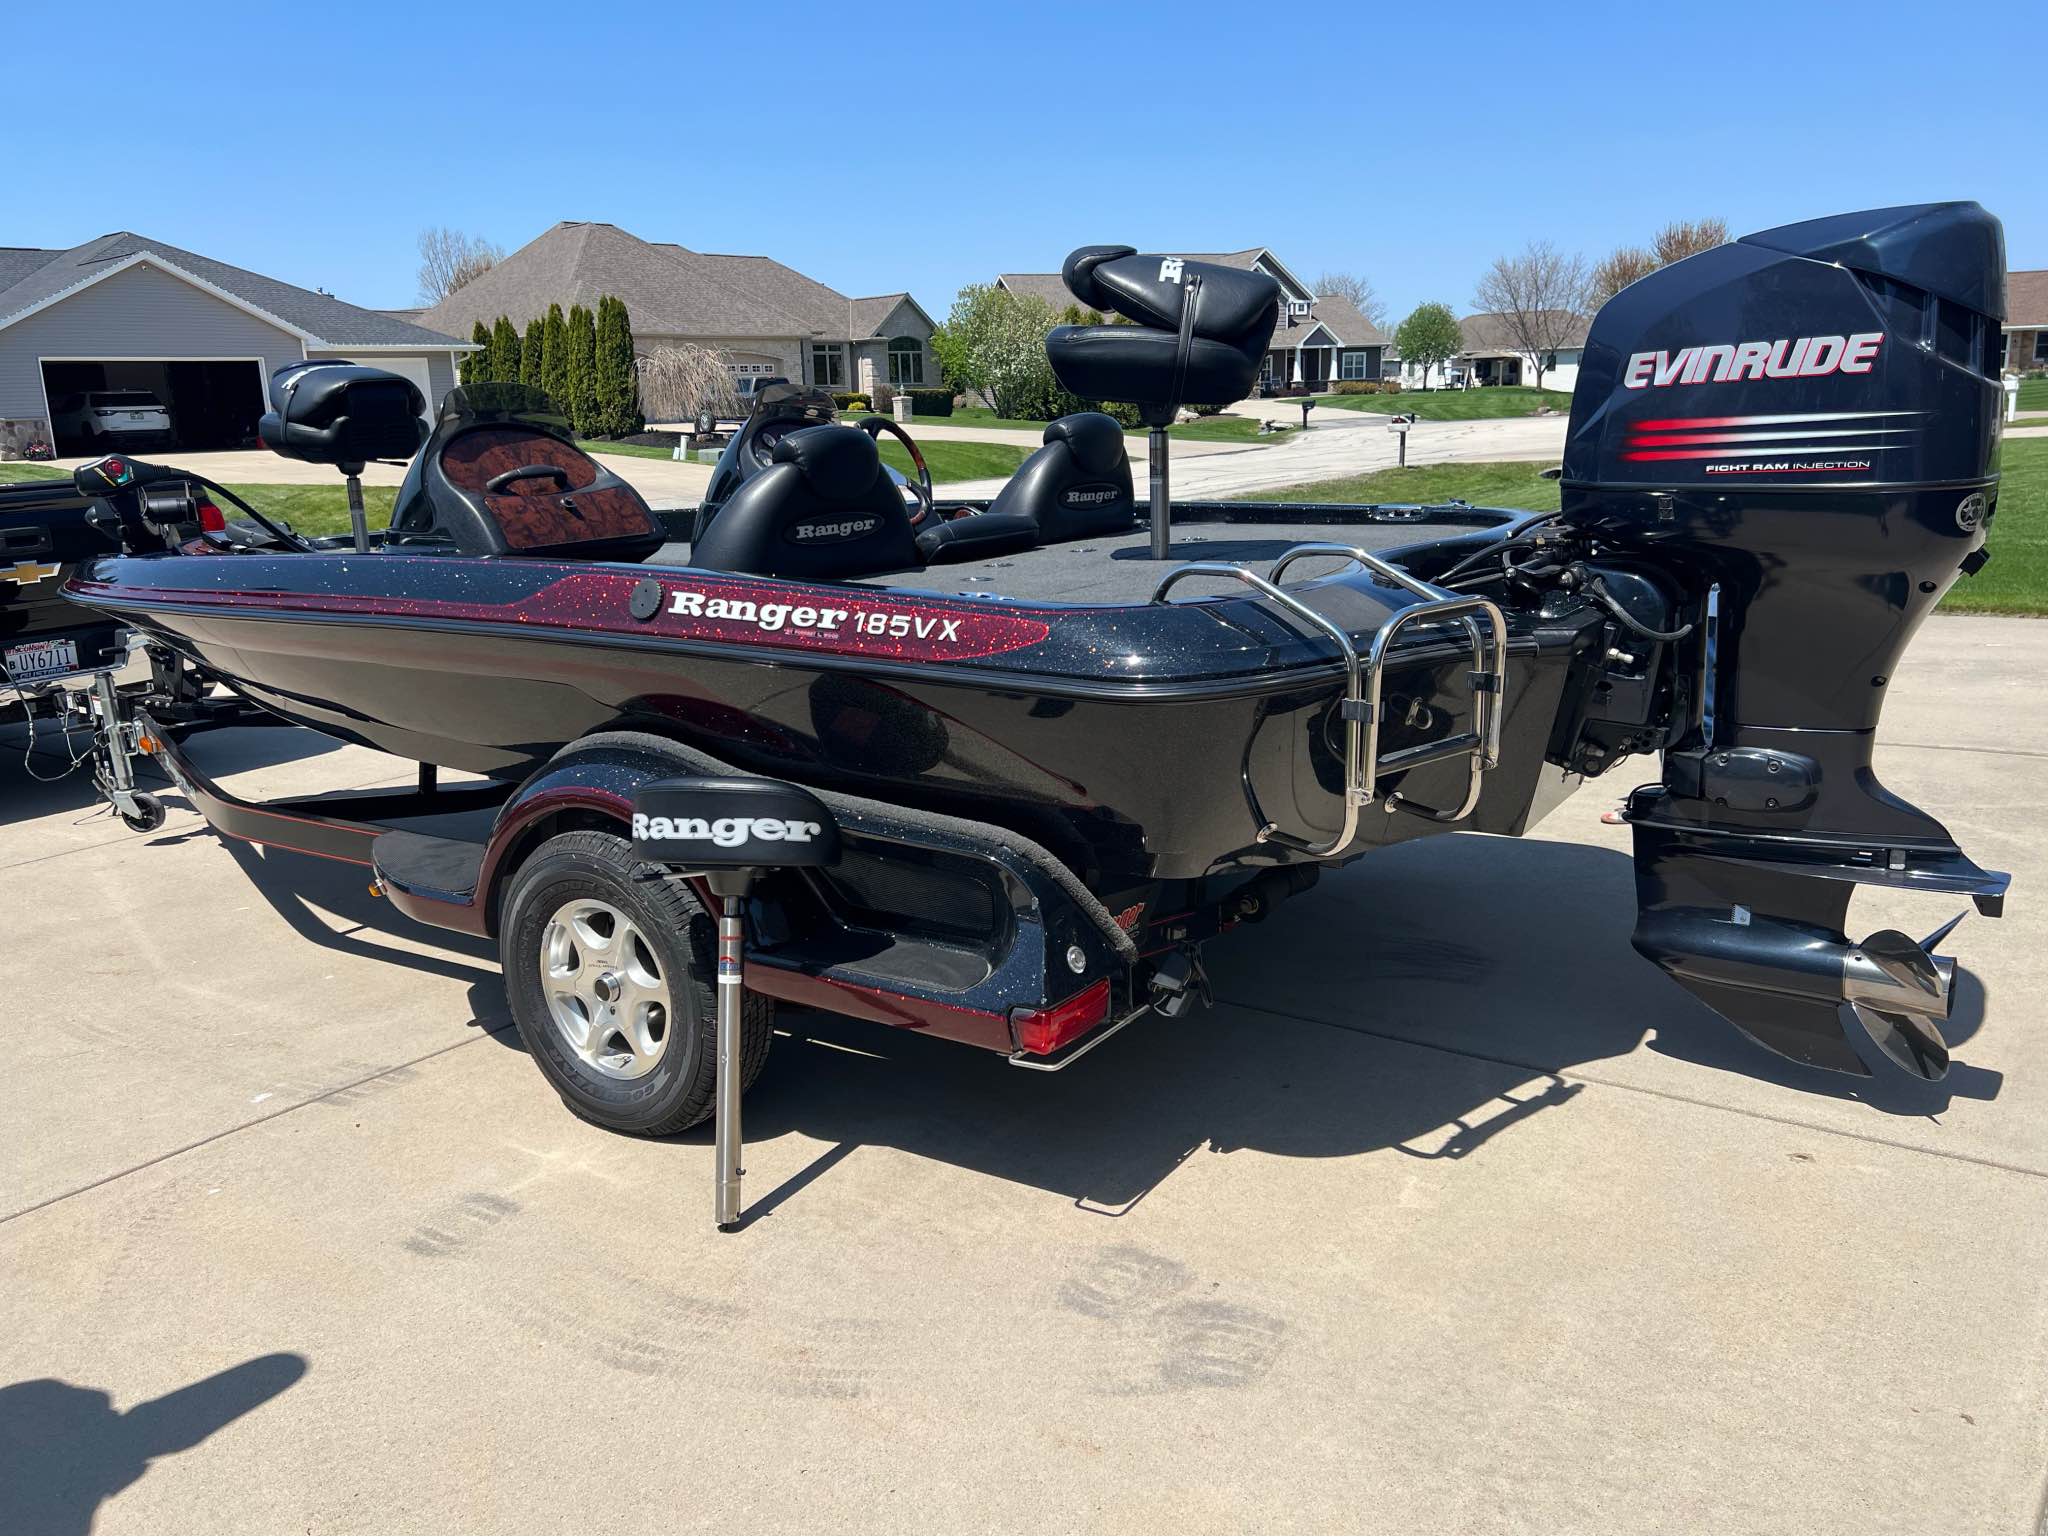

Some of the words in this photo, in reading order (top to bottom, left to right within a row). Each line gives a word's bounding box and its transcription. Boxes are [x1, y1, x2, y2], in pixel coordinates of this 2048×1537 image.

[1623, 332, 1885, 389] EVINRUDE
[1752, 463, 1789, 471] RAM
[1792, 461, 1871, 470] INJECTION
[1066, 488, 1118, 503] Ranger
[796, 518, 875, 539] Ranger
[668, 591, 848, 631] Ranger
[854, 611, 962, 642] 185VX
[20, 648, 71, 671] UY6711
[632, 812, 821, 847] Ranger
